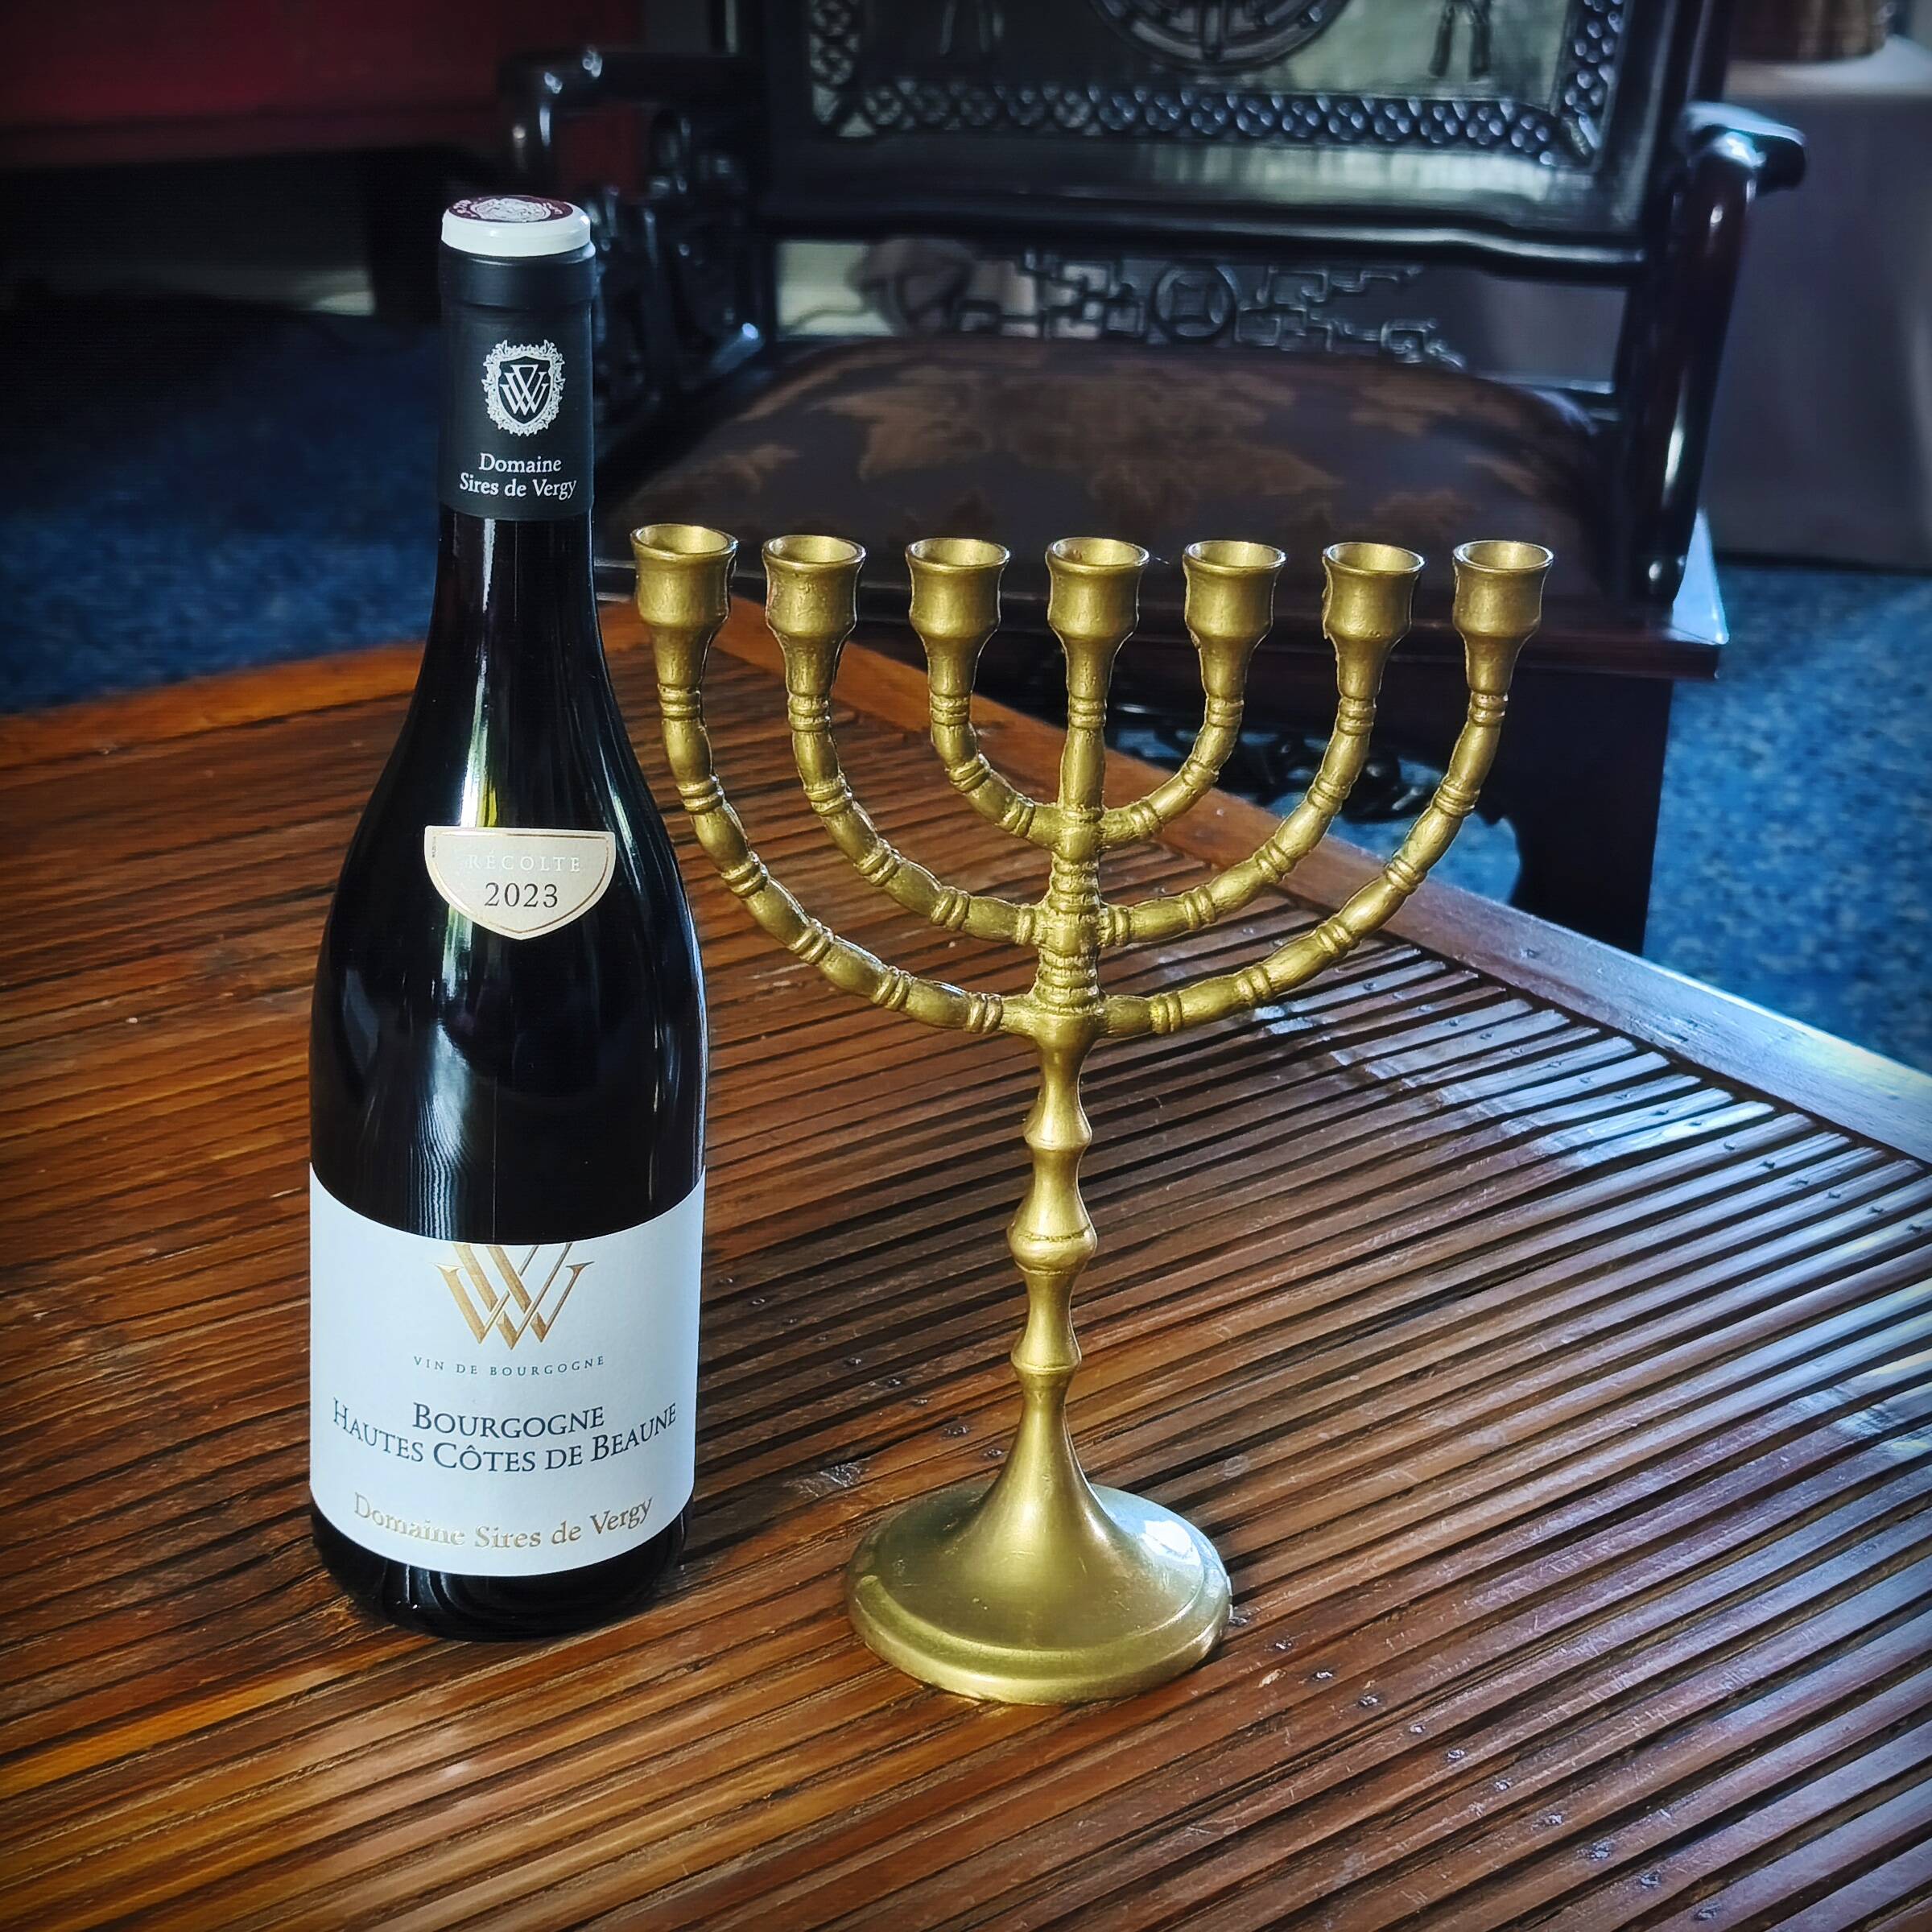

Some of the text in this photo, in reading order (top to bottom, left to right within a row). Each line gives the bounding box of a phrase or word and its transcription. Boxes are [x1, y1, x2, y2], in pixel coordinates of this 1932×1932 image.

[478, 452, 562, 473] Domaine
[460, 472, 577, 501] Sires de Vergy
[464, 850, 581, 873] RÉCOLTE
[484, 882, 558, 908] 2023
[414, 1356, 605, 1377] VIN DE BOURGOGNE
[412, 1402, 605, 1439] BOURGOGNE
[333, 1397, 677, 1472] HAUTES CÔTES DE BEAUNE
[354, 1492, 654, 1549] Domaine Sires de Vergy
